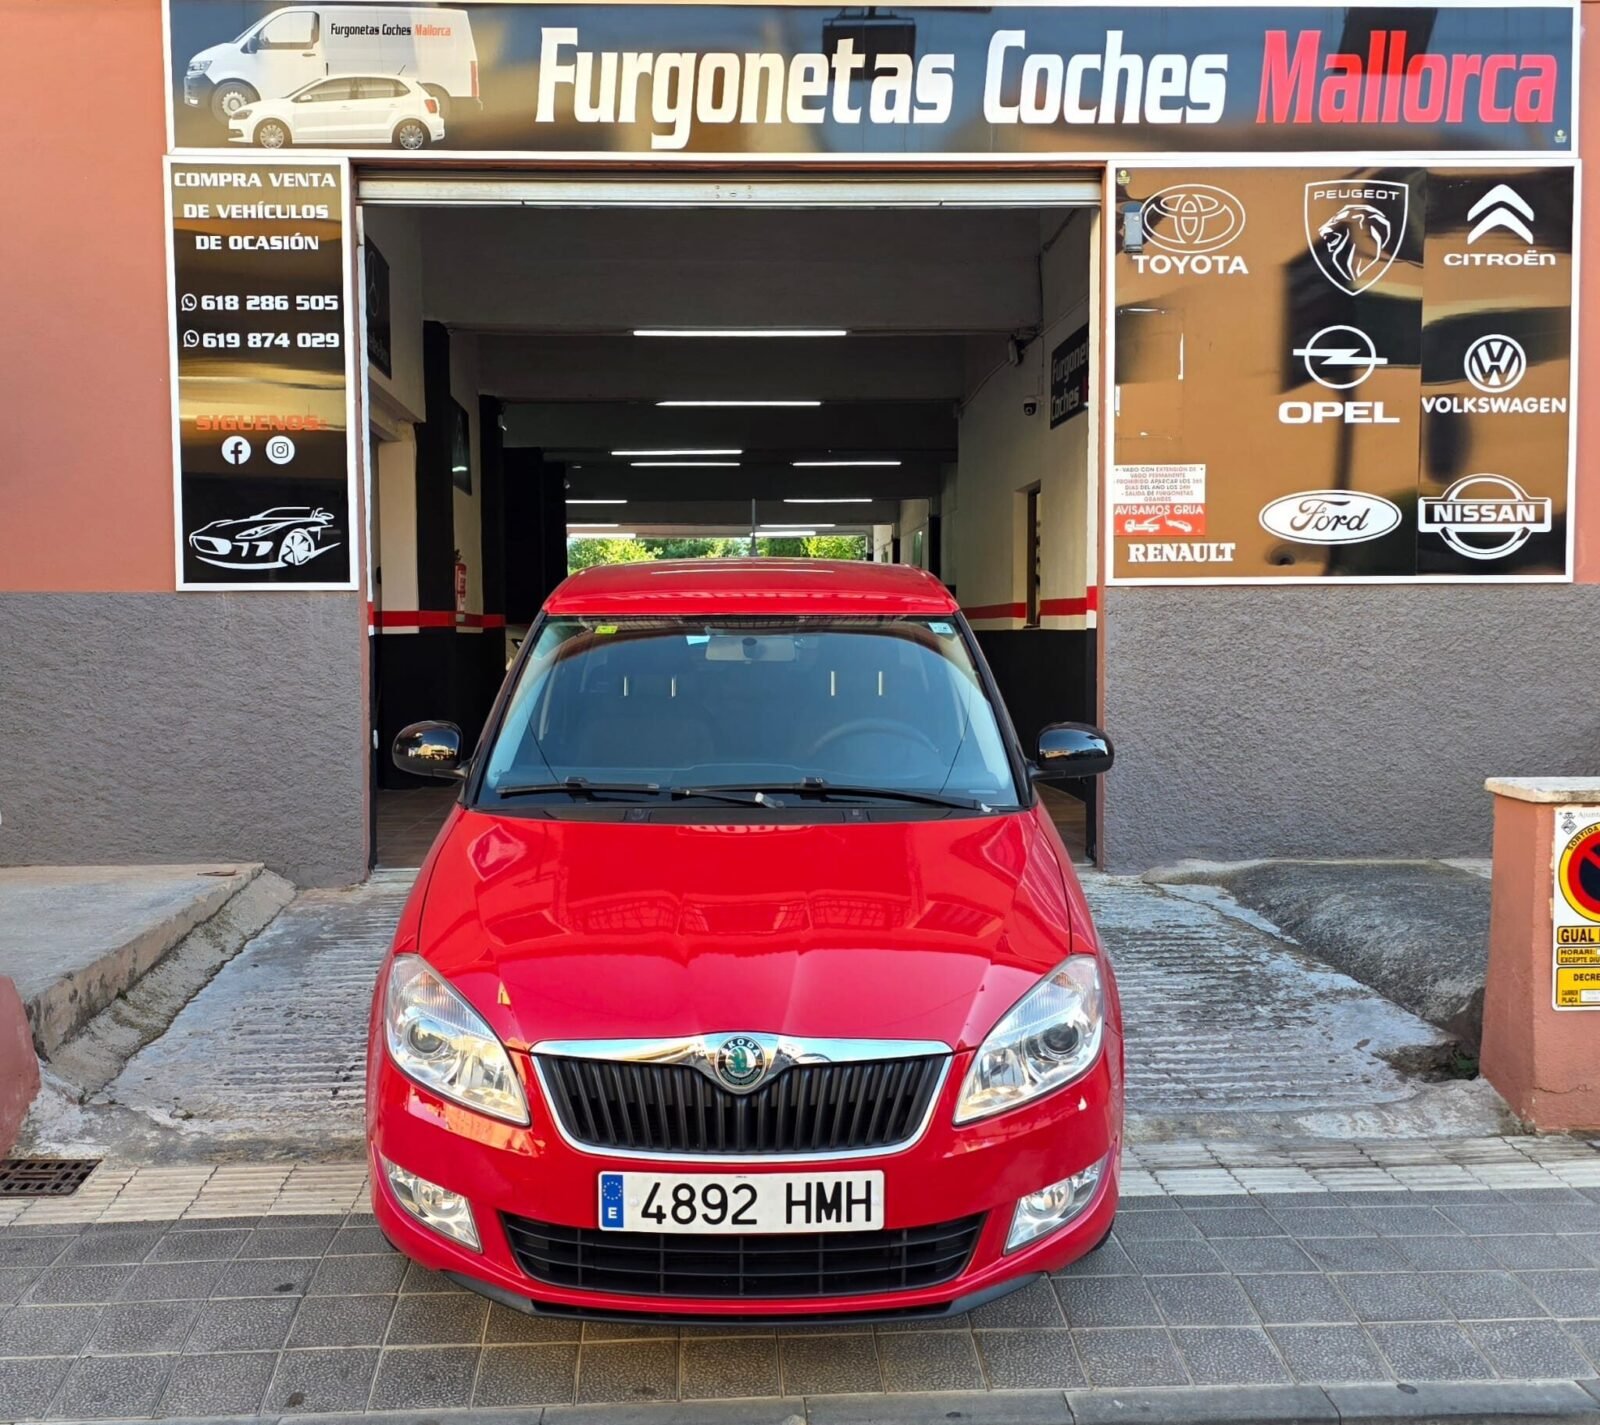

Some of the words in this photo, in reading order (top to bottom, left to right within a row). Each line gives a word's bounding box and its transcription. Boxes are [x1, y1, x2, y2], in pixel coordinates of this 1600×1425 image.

[331, 23, 379, 37] Furgonetas
[382, 24, 411, 35] Coches
[415, 24, 451, 36] Mallorca
[535, 27, 954, 149] Furgonetas
[983, 30, 1228, 124] Coches
[1256, 30, 1557, 123] Mallorca
[174, 172, 262, 187] COMPRA
[269, 173, 336, 187] VENTA
[1314, 189, 1400, 200] PEUGEOT
[184, 204, 209, 218] DE
[216, 201, 329, 219] VEHÍCULOS
[196, 235, 222, 250] DE
[229, 232, 319, 250] OCASIÓN
[1132, 255, 1248, 274] TOYOTA
[1444, 250, 1556, 265] CITROËN
[201, 295, 239, 310] 618
[246, 295, 288, 310] 286
[296, 295, 338, 310] 505
[202, 333, 240, 348] 619
[247, 333, 290, 348] 874
[297, 333, 339, 348] 029
[1051, 386, 1080, 421] Coches
[1421, 397, 1566, 413] VOLKSWAGEN
[1278, 401, 1400, 424] OPEL
[1115, 505, 1170, 515] AVISAMOS
[1174, 505, 1204, 514] GRUA
[1290, 499, 1370, 531] Ford
[1433, 504, 1535, 522] NISSAN
[1128, 543, 1236, 562] RENAULT
[1568, 826, 1599, 850] SORTIDA
[1561, 928, 1595, 942] GUAL
[1573, 973, 1600, 981] DECRE
[641, 1182, 758, 1225] 4892
[785, 1180, 872, 1224] HMH
[608, 1207, 617, 1219] E
